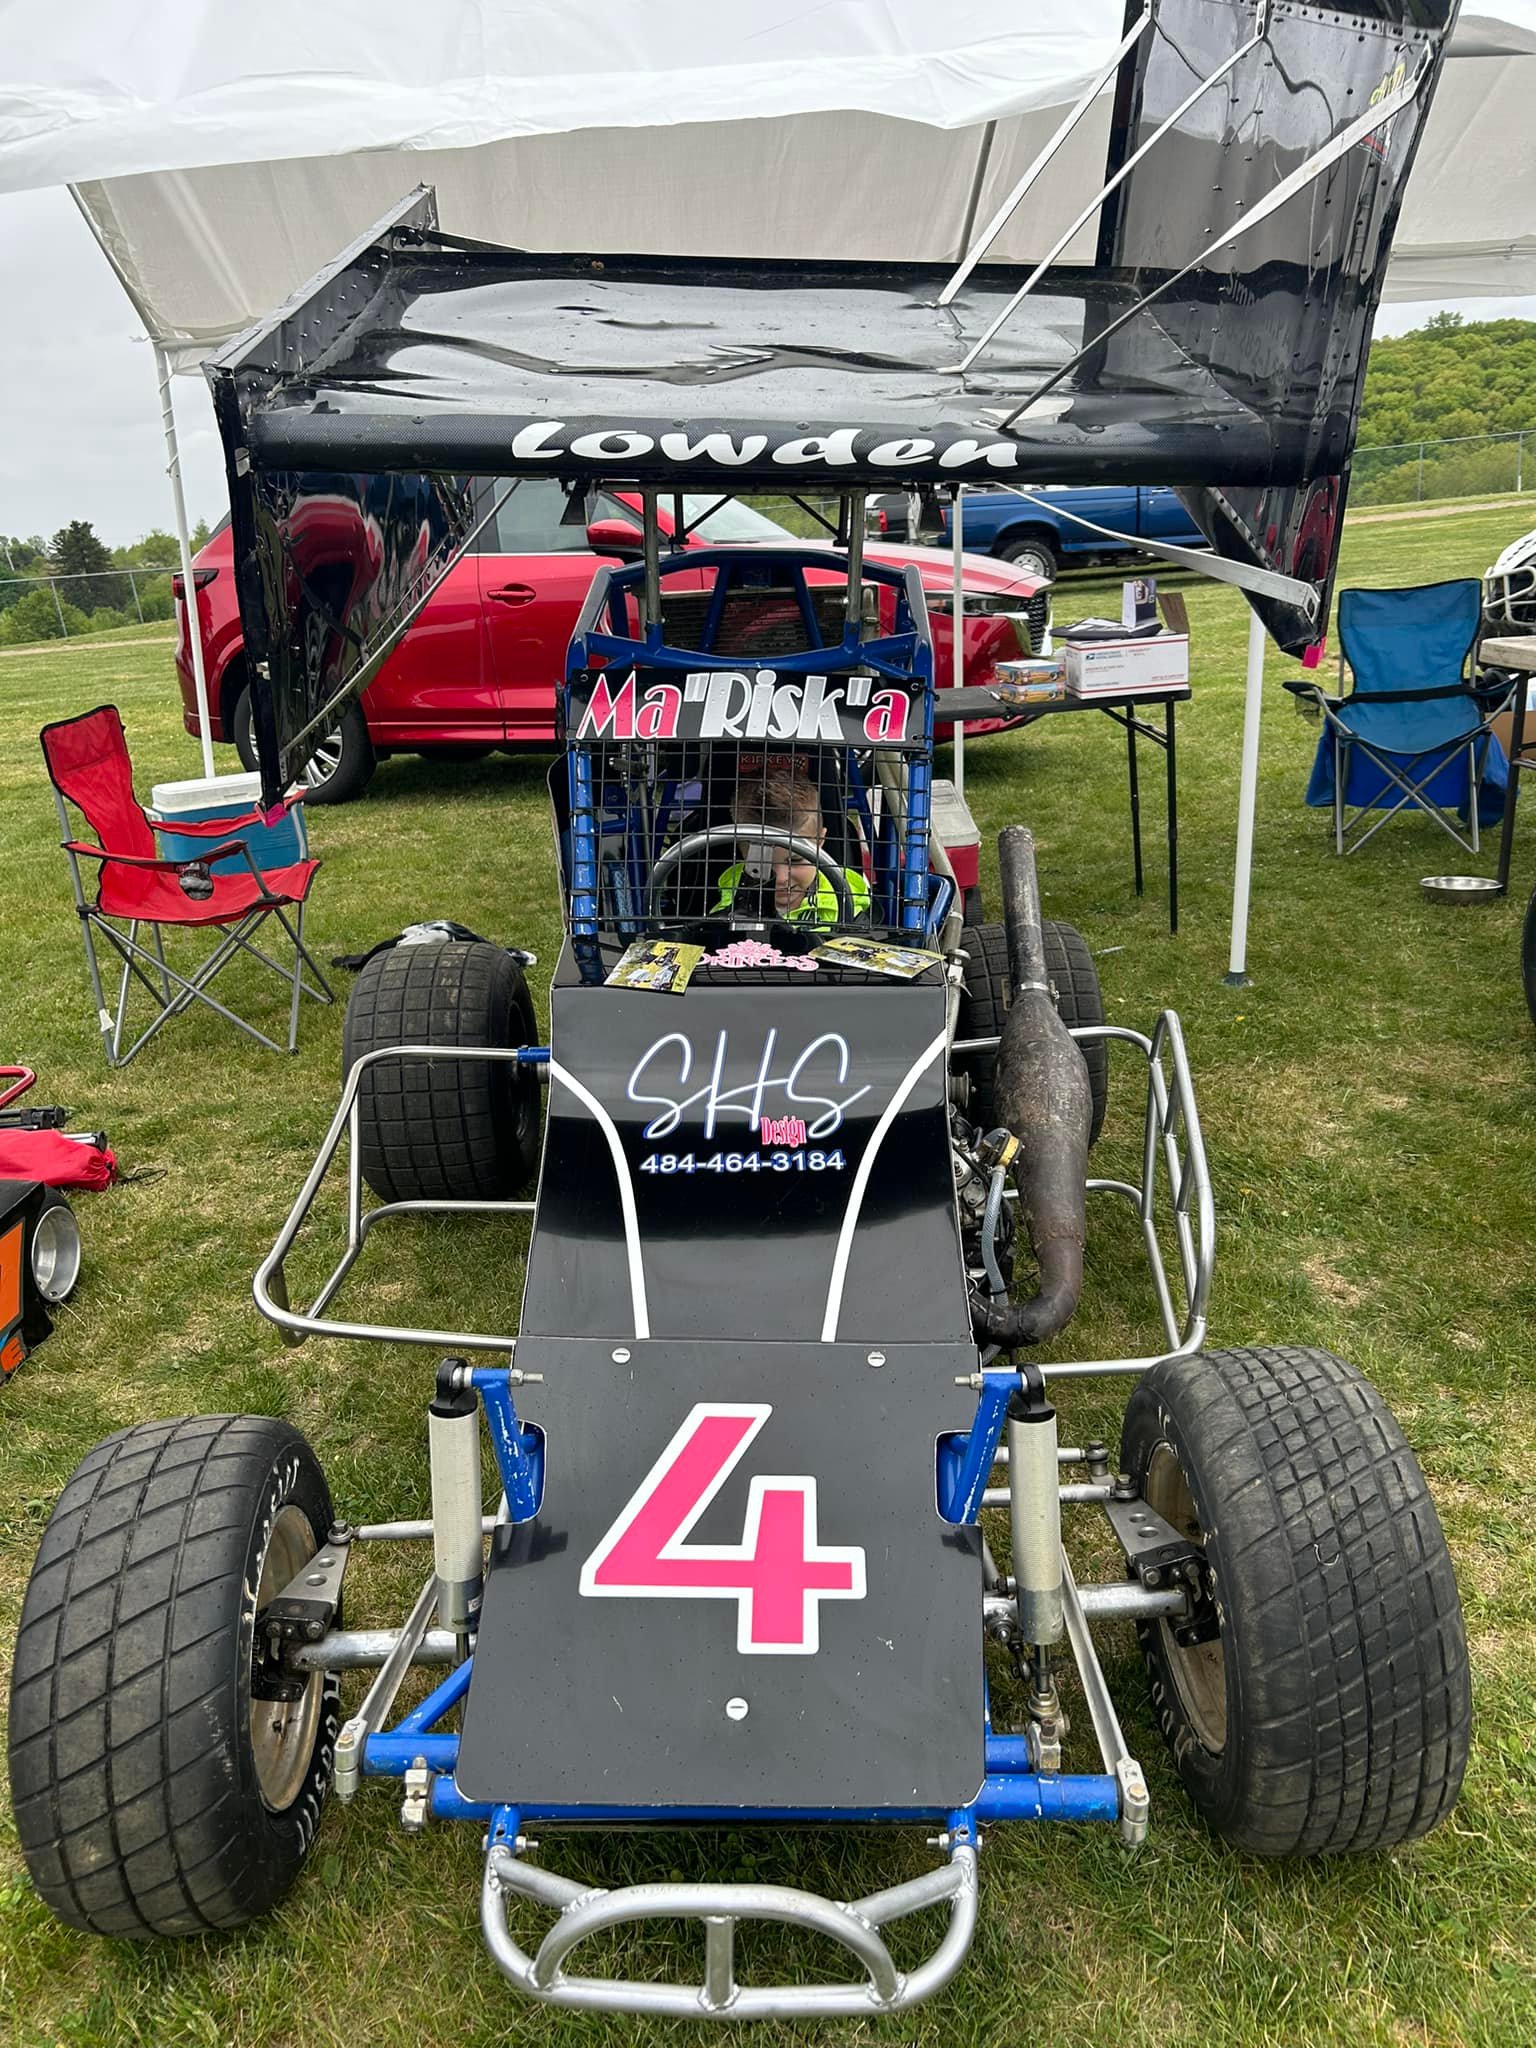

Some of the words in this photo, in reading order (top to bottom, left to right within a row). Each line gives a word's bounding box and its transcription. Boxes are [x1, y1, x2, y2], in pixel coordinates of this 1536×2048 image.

[511, 421, 1019, 467] Lowden
[575, 669, 911, 741] Ma"Risk"a
[627, 1028, 873, 1140] SHS
[760, 1114, 807, 1148] Design
[639, 1149, 846, 1174] 484-464-3184
[579, 1402, 867, 1654] 4
